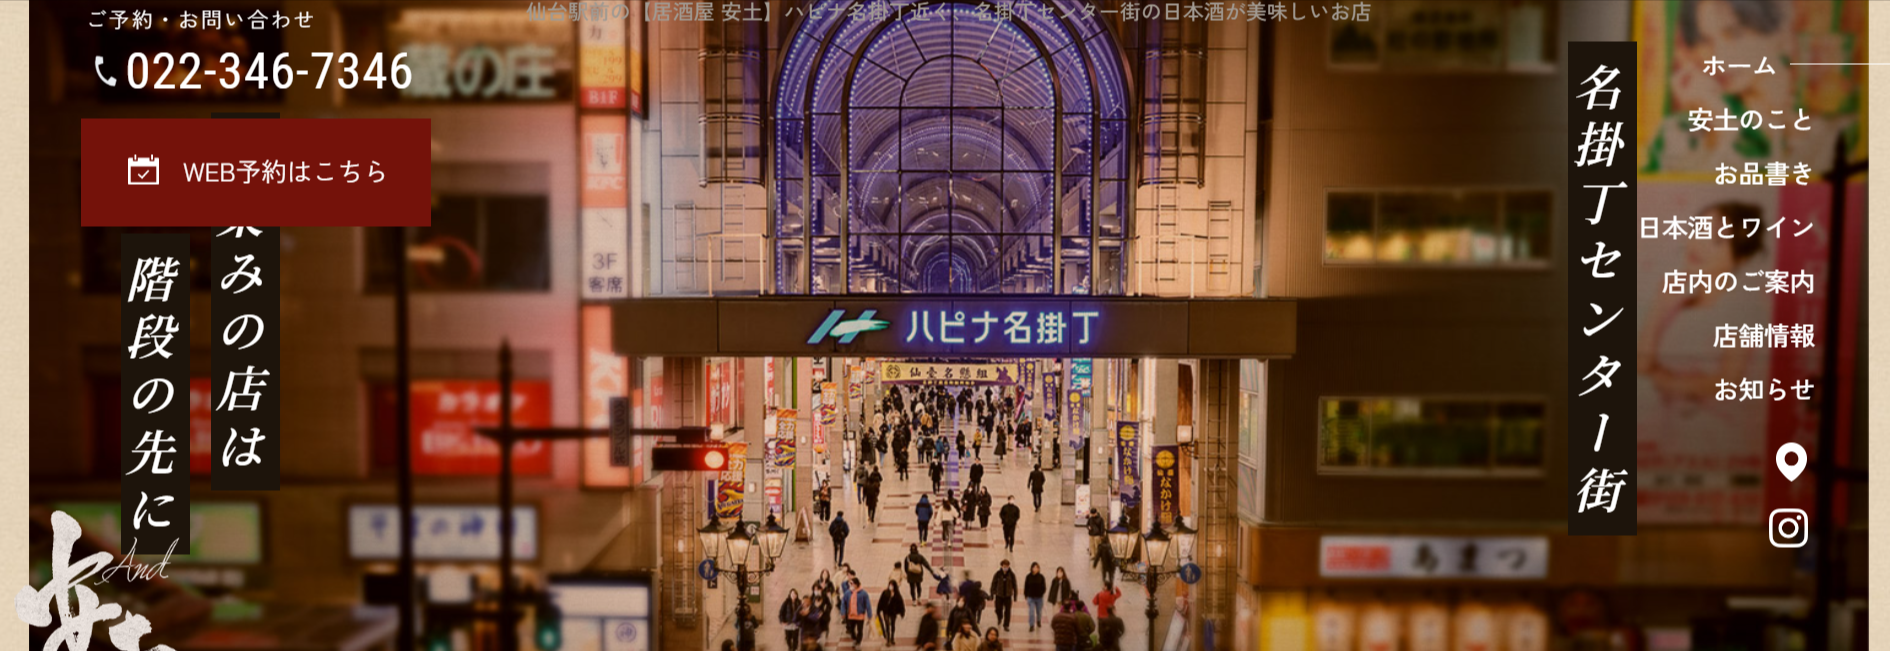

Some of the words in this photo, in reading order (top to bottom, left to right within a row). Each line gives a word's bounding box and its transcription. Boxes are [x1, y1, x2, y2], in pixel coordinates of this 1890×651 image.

[592, 253, 618, 270] 3F
[906, 310, 1099, 344] ハピナ名掛丁
